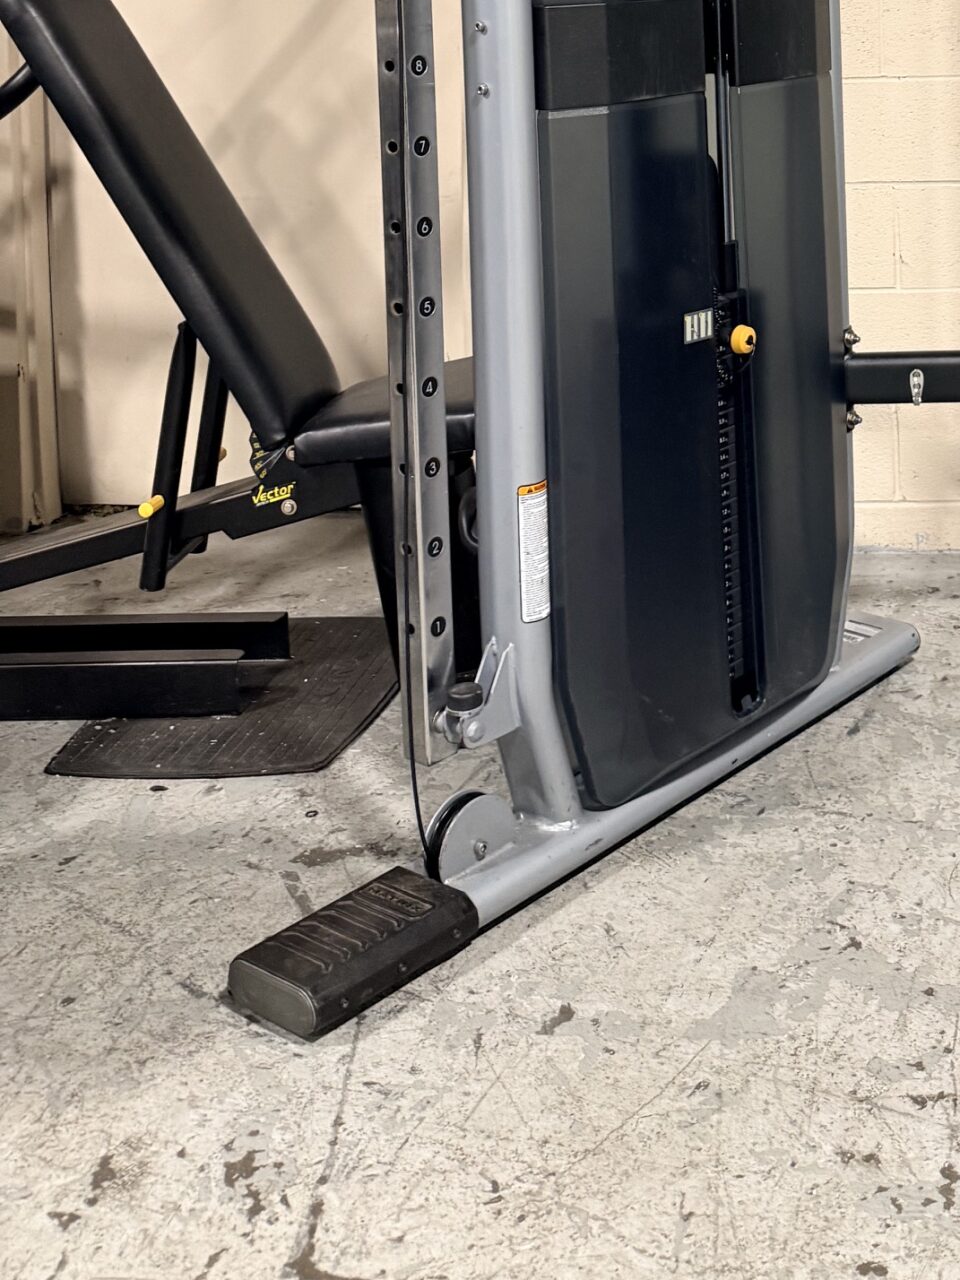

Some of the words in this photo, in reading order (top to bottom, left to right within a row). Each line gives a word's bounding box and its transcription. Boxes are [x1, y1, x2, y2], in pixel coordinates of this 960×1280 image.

[415, 60, 423, 72] 8
[419, 140, 426, 153] 7
[421, 221, 429, 233] 6
[424, 301, 432, 314] 5
[426, 381, 433, 393] 4
[429, 462, 436, 474] 3
[252, 484, 293, 504] Vector
[432, 541, 439, 554] 2
